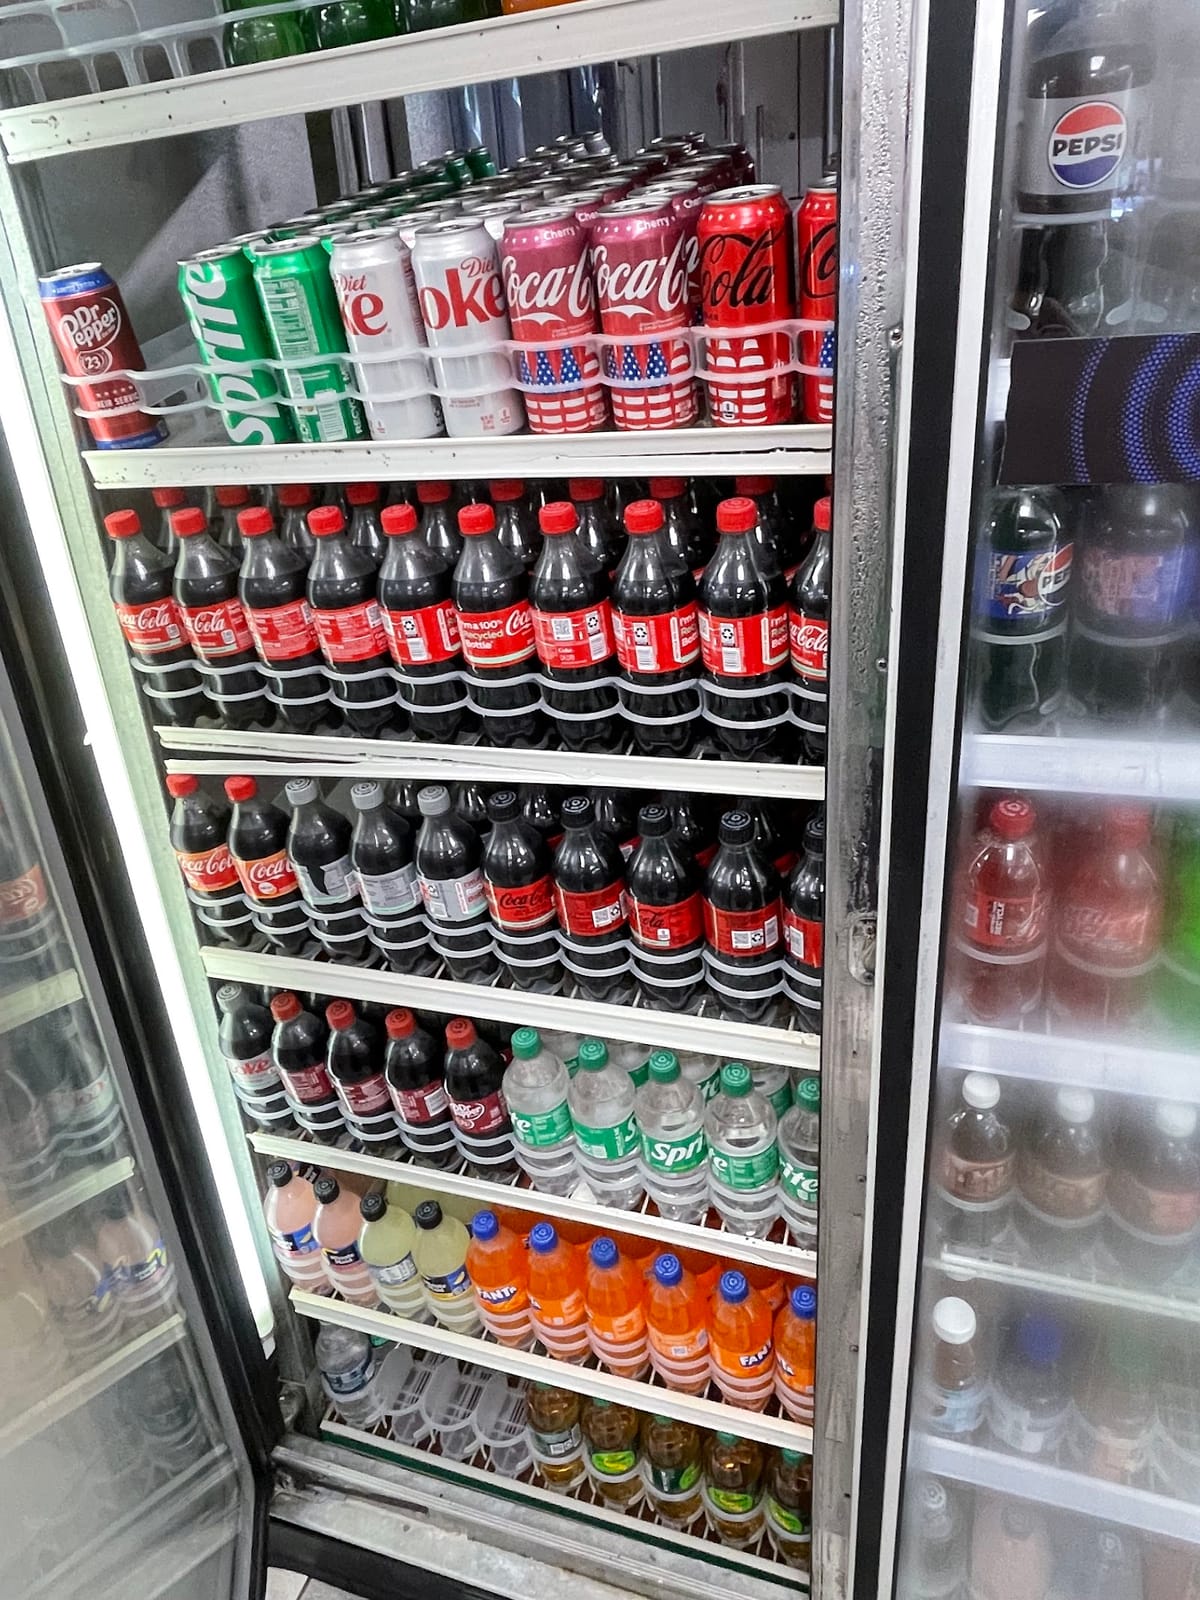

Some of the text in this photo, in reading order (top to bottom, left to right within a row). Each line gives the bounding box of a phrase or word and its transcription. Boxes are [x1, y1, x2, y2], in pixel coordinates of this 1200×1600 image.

[1052, 134, 1122, 156] PEPSI
[542, 225, 576, 241] Cherry
[634, 214, 670, 232] Cherry
[74, 304, 100, 329] Dr
[60, 308, 117, 350] Pepper
[84, 355, 102, 371] 23
